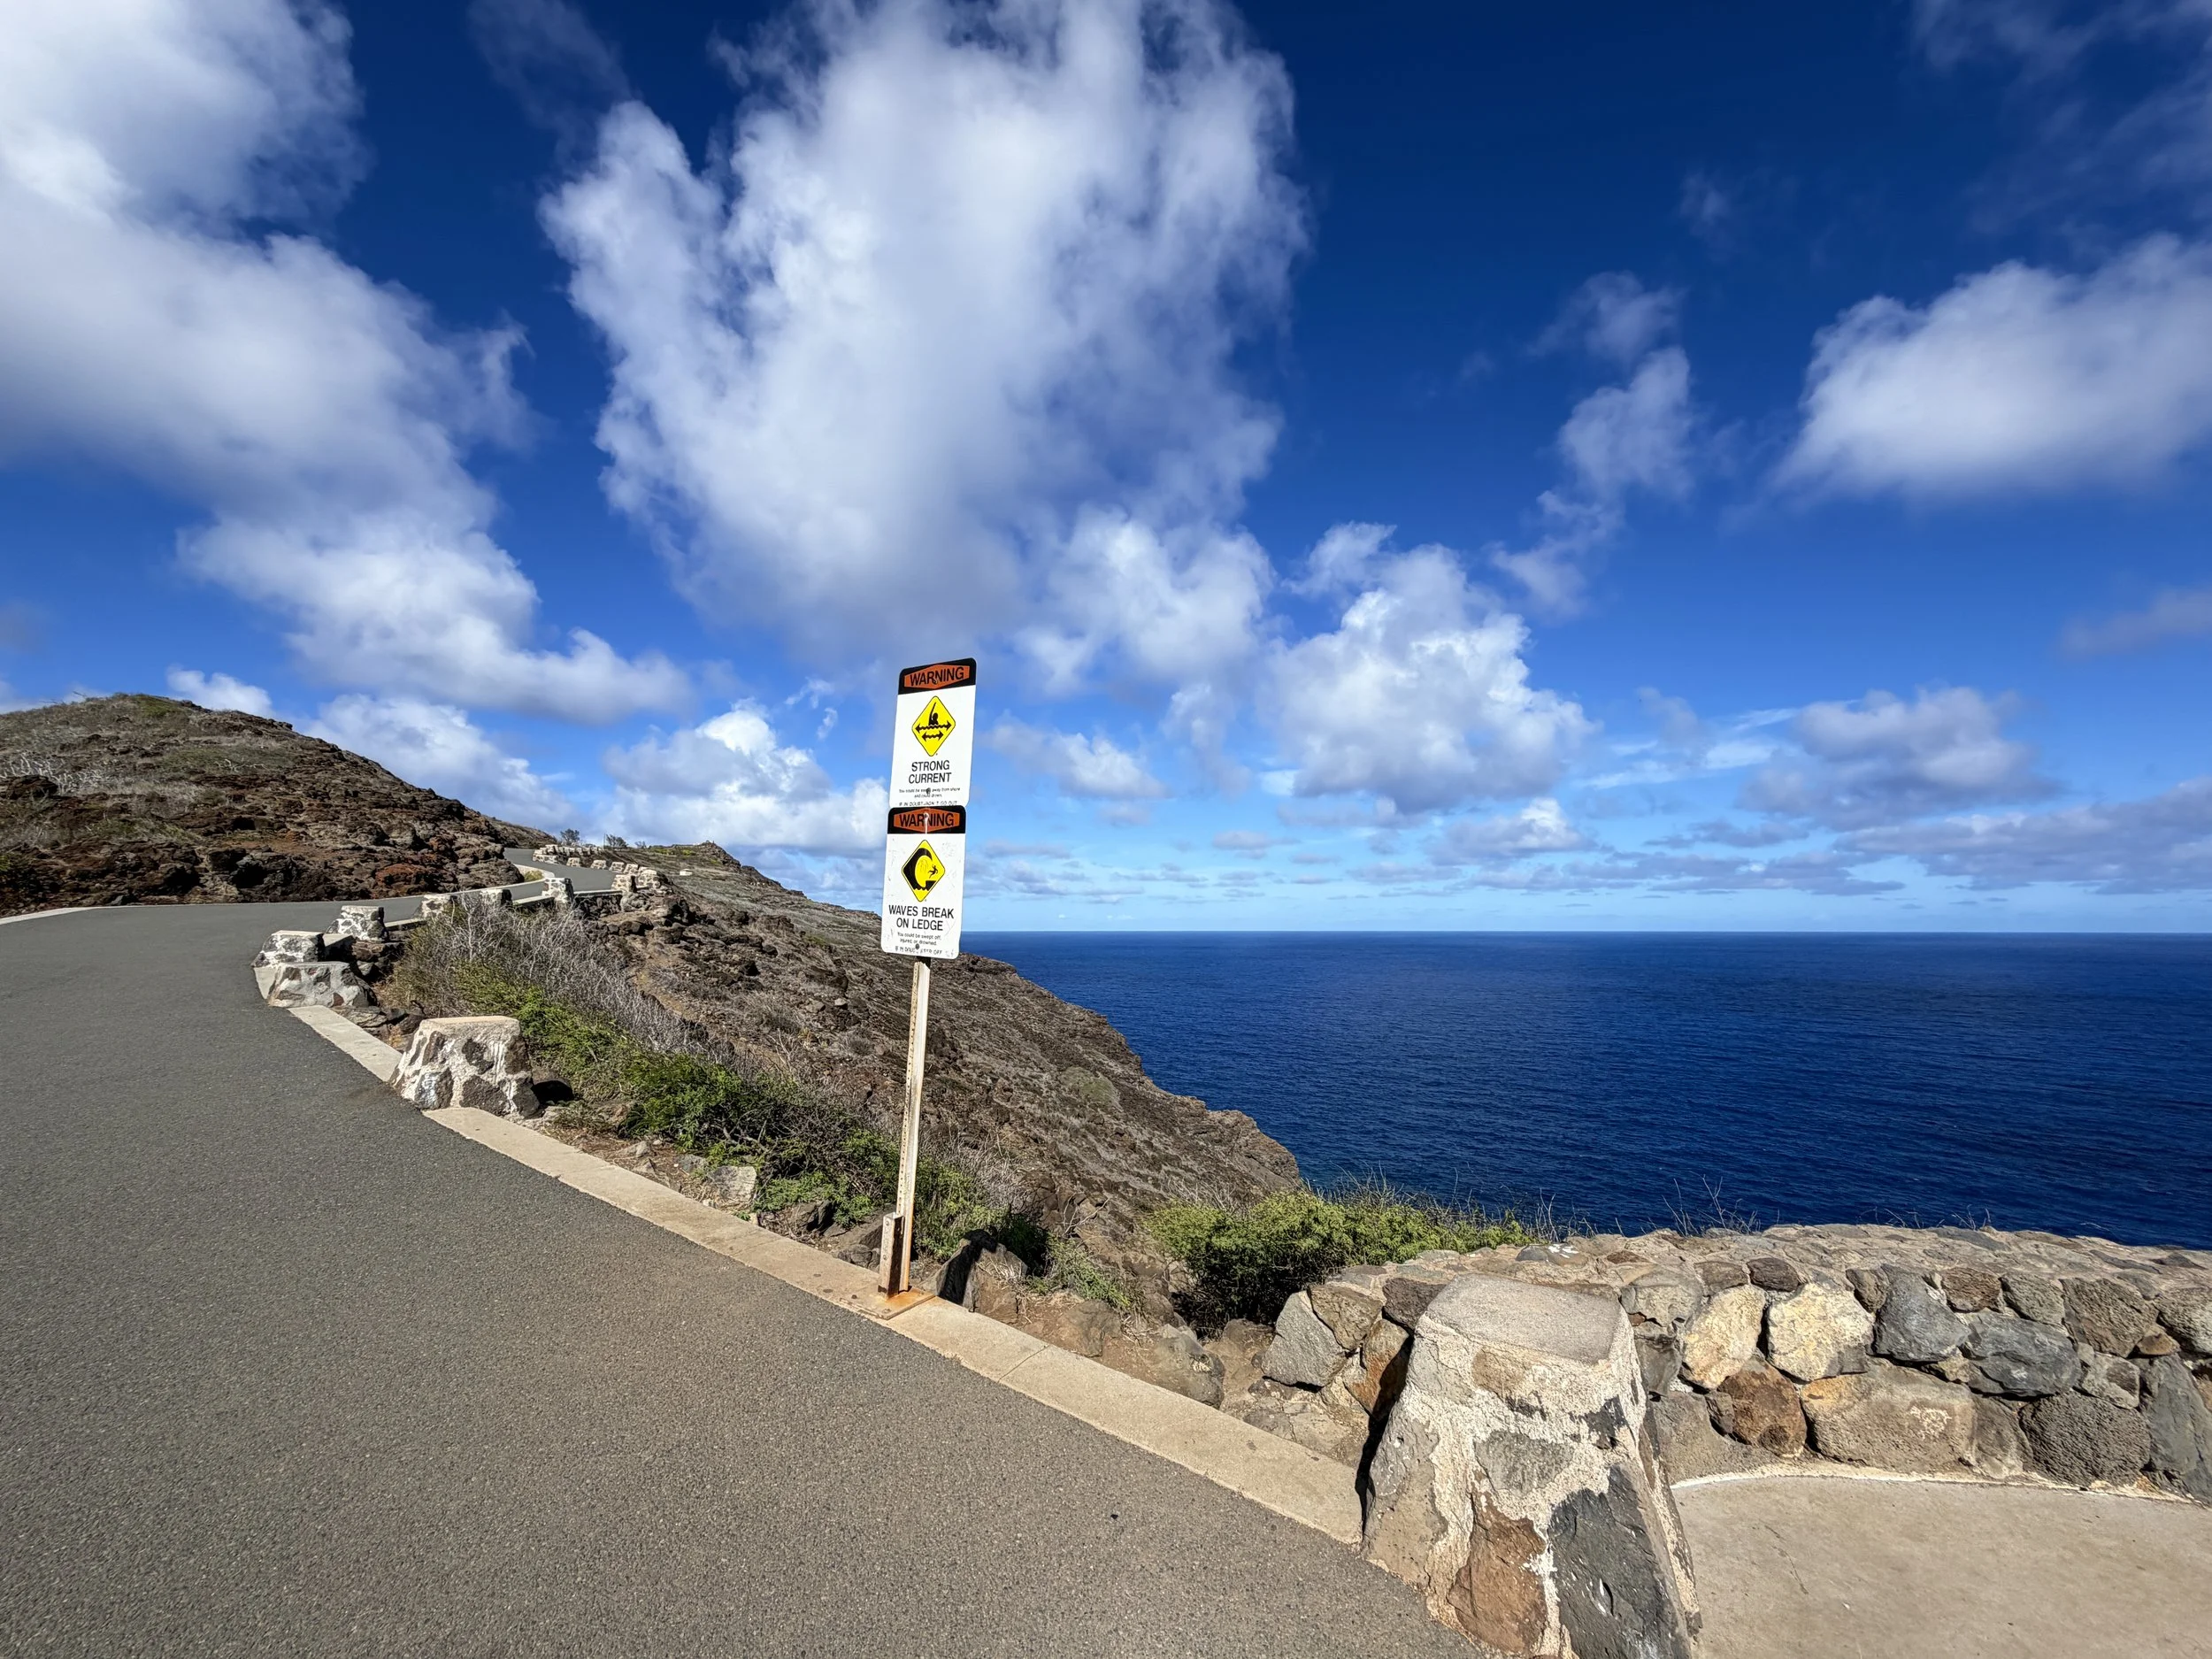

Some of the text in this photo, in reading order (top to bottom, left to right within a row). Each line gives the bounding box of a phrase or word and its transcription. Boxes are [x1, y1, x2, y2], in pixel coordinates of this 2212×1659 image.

[910, 666, 964, 687] WARNING
[911, 760, 950, 772] STRONG
[908, 772, 952, 785] CURRENT
[899, 812, 955, 827] WARNING
[888, 904, 955, 919] WAVES BREAK
[896, 917, 944, 932] ON LEDGE
